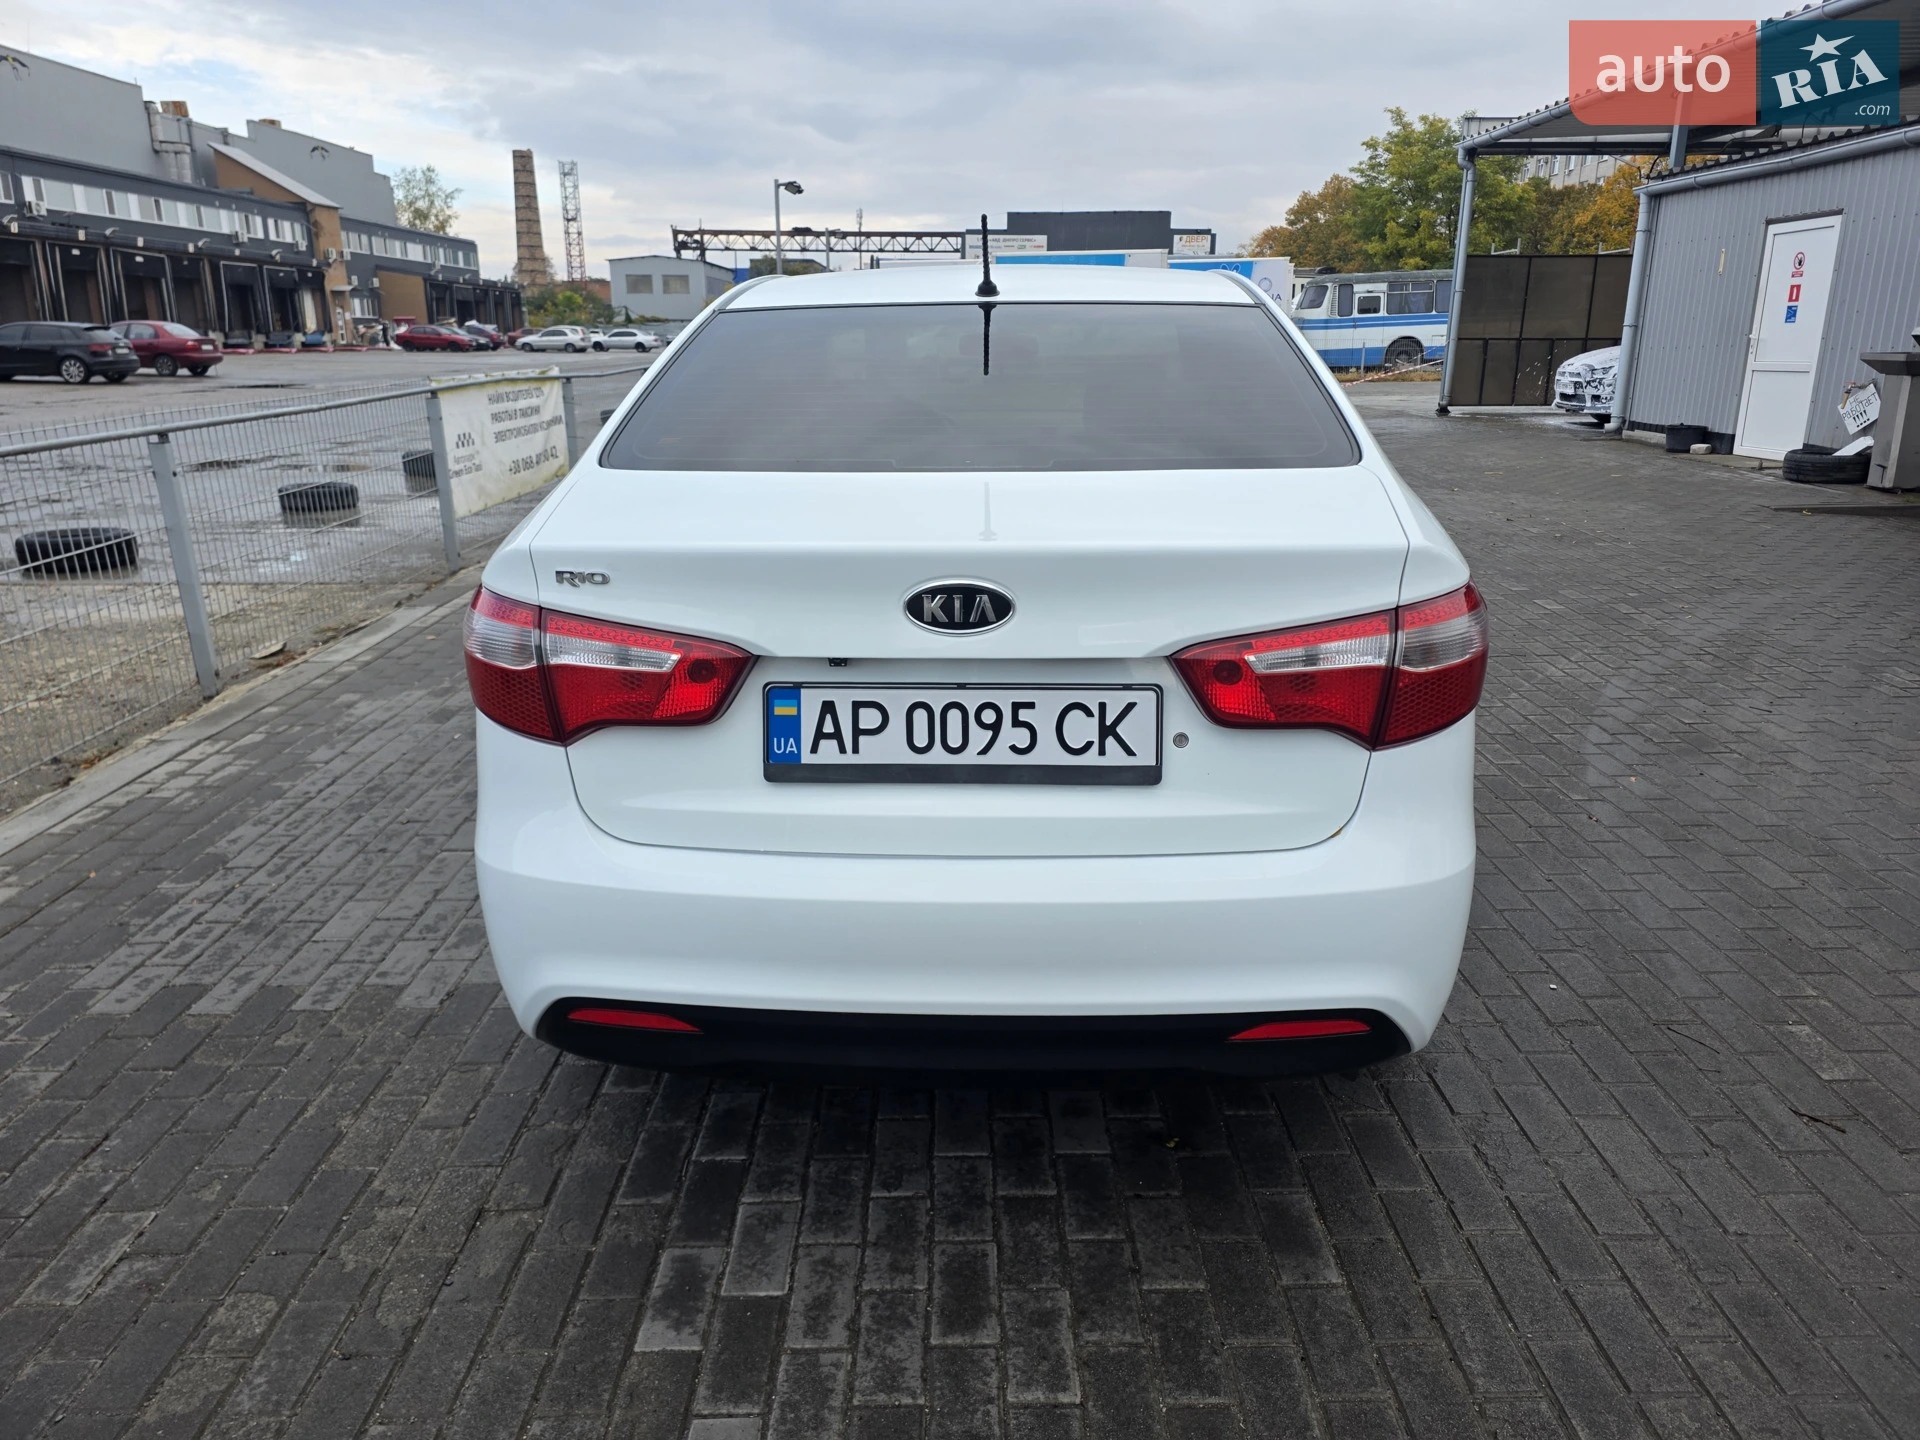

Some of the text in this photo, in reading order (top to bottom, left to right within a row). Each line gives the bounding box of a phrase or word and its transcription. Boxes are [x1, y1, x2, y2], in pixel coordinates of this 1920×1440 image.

[1184, 235, 1208, 244] ДВЕРІ
[487, 391, 505, 405] НАЙМ
[505, 387, 533, 403] ВОДИТЕЛЕЙ
[1849, 395, 1862, 406] НЕ
[491, 408, 514, 424] РАБОТЫ
[519, 406, 534, 419] ТАКСИ
[509, 459, 521, 475] +38
[522, 455, 534, 472] 068
[550, 445, 559, 459] 42
[555, 569, 611, 587] RIO
[922, 593, 998, 623] KIA
[808, 699, 1139, 758] AP 0095 CK
[773, 736, 798, 755] UA
